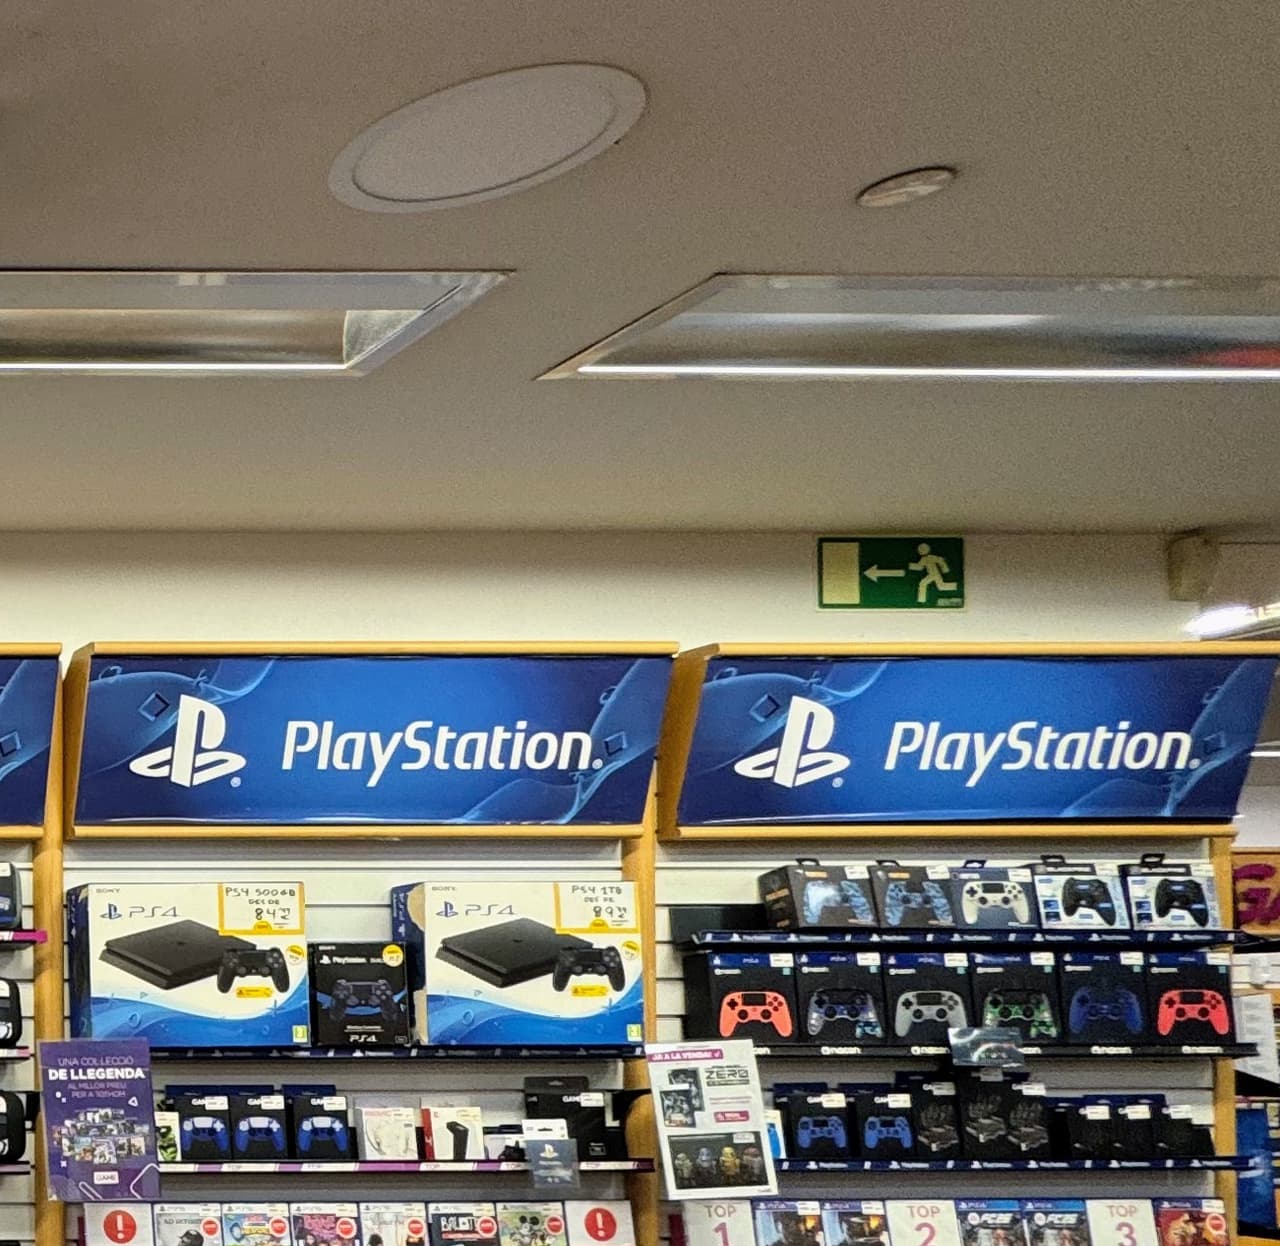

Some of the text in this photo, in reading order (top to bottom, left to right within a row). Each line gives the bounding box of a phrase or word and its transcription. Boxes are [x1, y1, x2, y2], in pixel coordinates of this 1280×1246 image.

[282, 720, 593, 787] PlayStation
[884, 720, 1191, 788] PlayStation
[225, 887, 249, 898] PS4
[128, 905, 180, 918] PS4
[465, 904, 516, 917] PS4
[349, 1034, 378, 1043] PS4
[57, 1057, 77, 1067] UNA
[48, 1067, 146, 1081] DE LLEGENDA
[705, 1069, 750, 1080] ZERO
[704, 1205, 737, 1218] TOP
[906, 1205, 940, 1218] TOP
[1107, 1205, 1138, 1218] TOP
